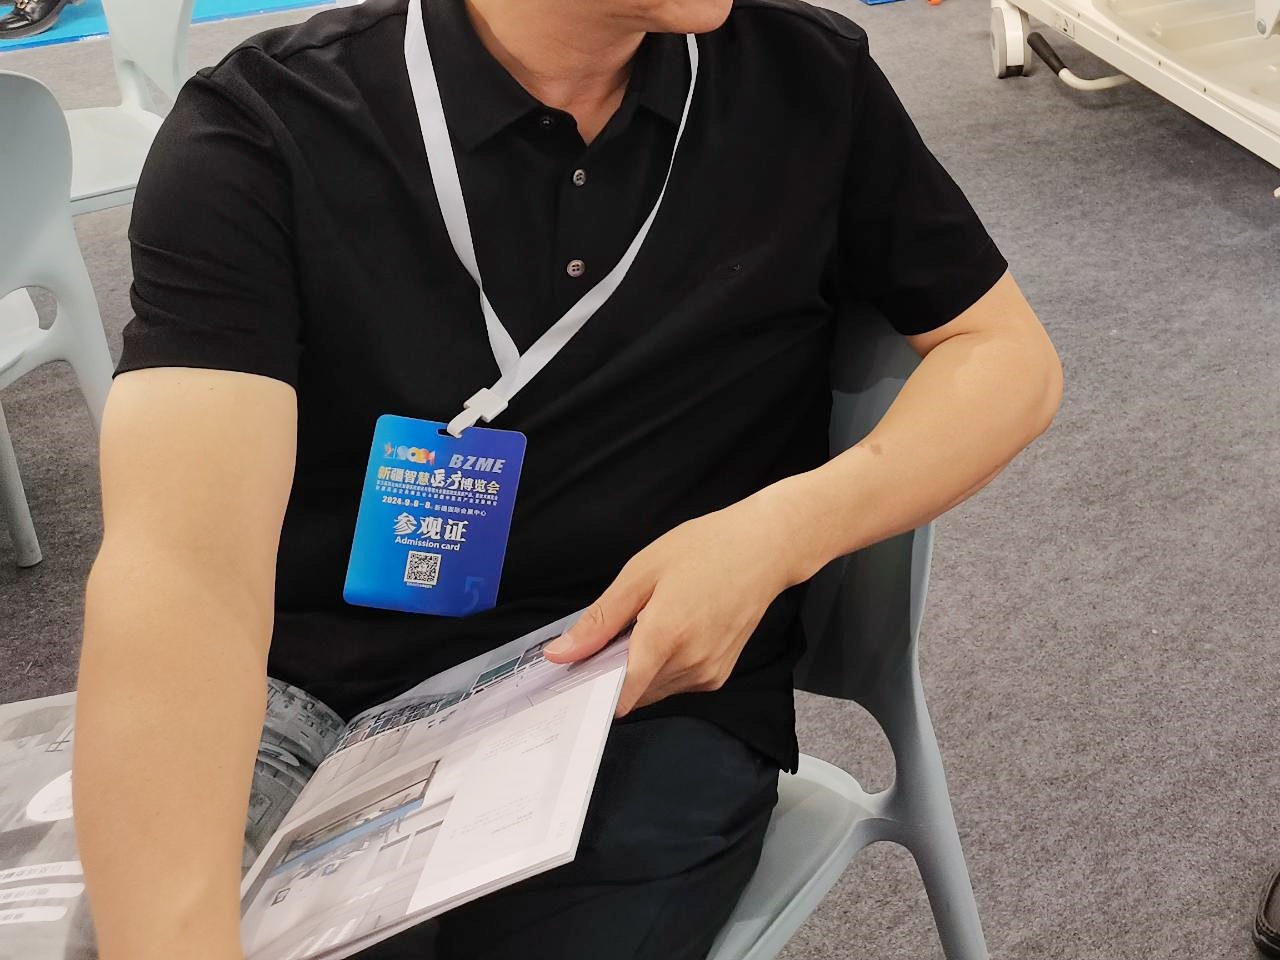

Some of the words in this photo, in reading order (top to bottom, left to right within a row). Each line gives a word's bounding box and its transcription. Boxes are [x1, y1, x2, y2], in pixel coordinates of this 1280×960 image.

[449, 453, 506, 474] BZME
[377, 465, 501, 495] 新疆智慧医疗博览会
[393, 512, 469, 542] 参观证
[395, 536, 440, 548] Admission
[441, 541, 461, 551] card
